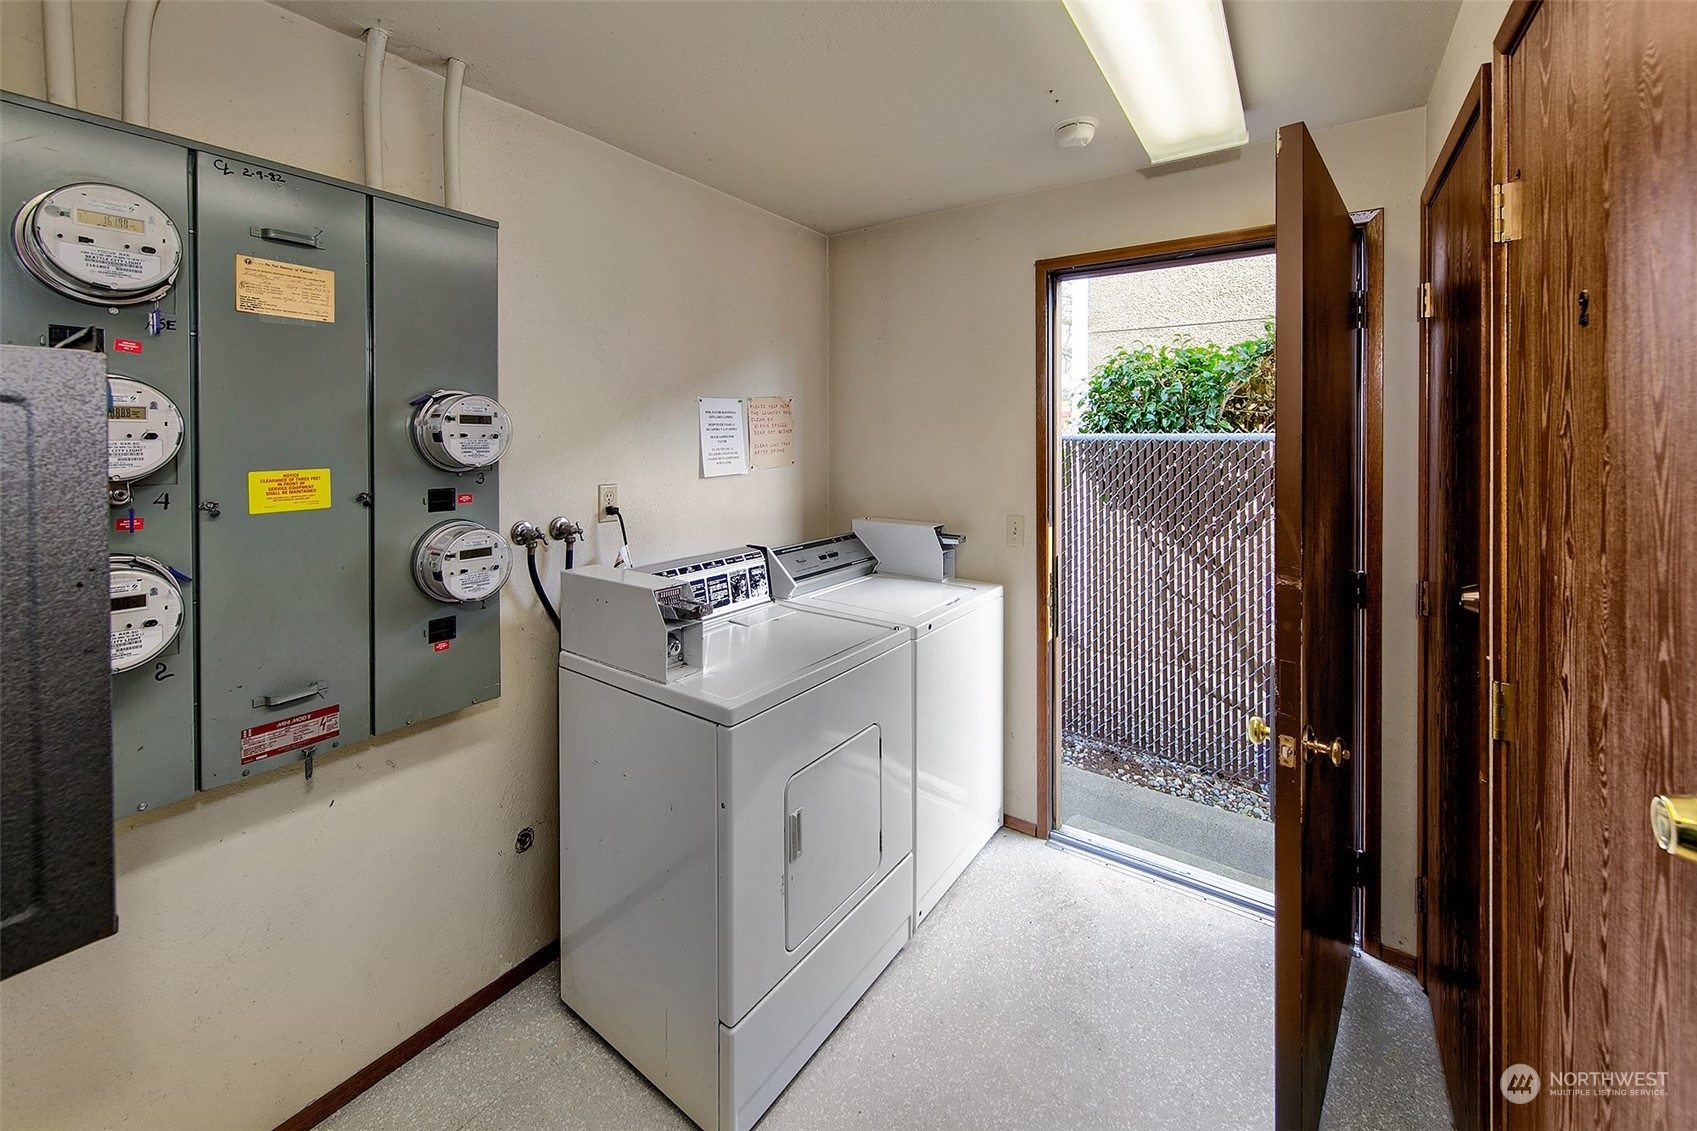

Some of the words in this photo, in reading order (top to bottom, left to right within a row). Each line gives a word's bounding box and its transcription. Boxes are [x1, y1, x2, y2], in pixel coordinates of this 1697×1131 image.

[476, 472, 485, 484] 3
[153, 492, 170, 510] 4
[154, 662, 176, 681] 2
